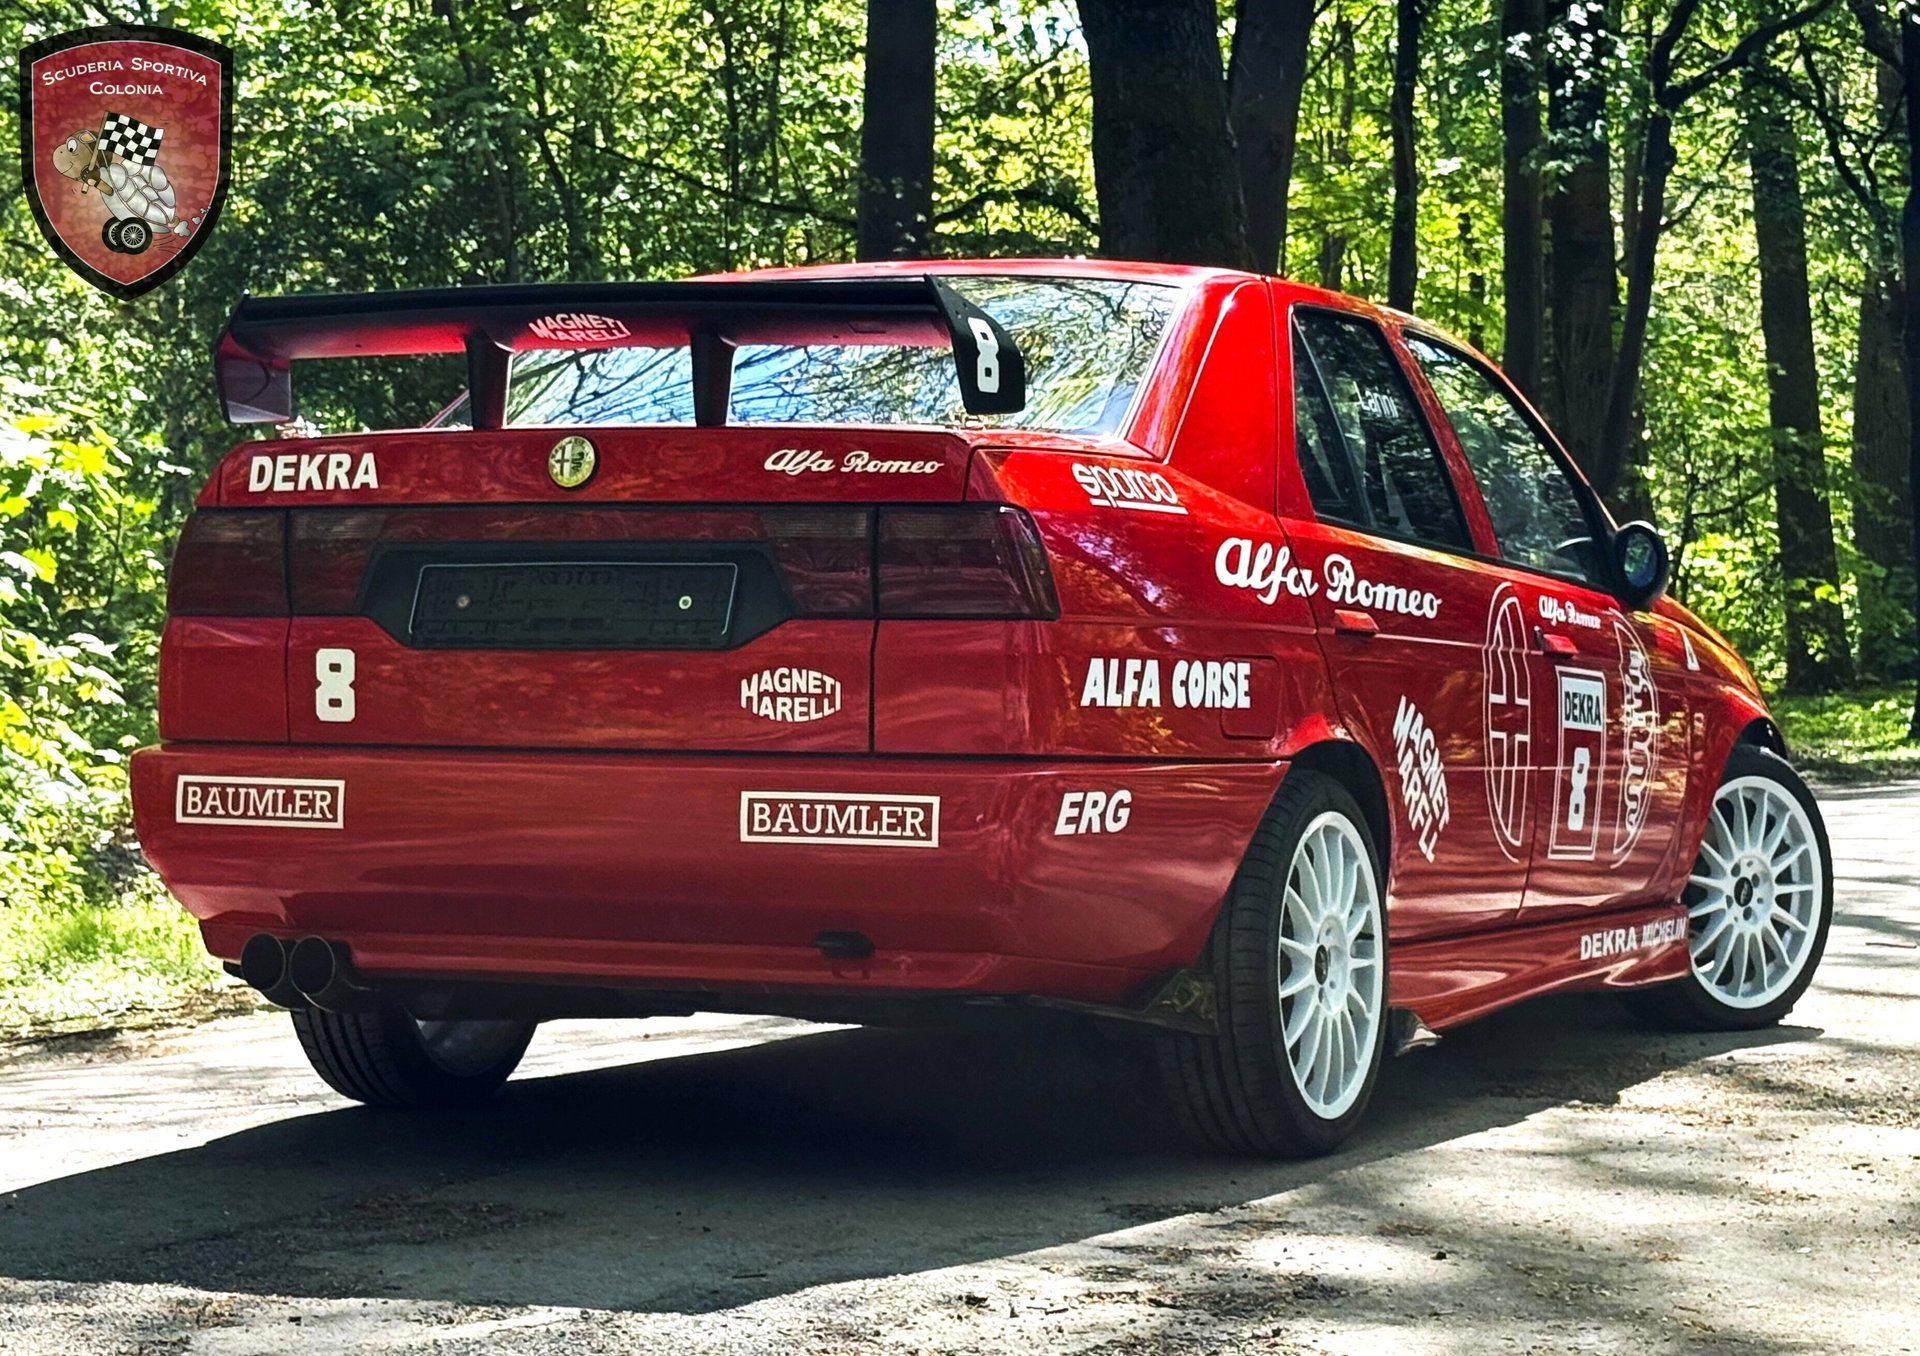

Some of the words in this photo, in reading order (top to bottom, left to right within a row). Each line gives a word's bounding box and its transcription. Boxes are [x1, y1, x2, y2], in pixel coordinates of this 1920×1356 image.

[968, 316, 1000, 394] 8
[248, 452, 379, 492] DEKRA
[763, 448, 836, 476] Alfa
[840, 450, 945, 475] Romeo
[1071, 462, 1179, 508] sparco
[1214, 536, 1320, 606] Alfa
[1323, 553, 1443, 620] Romeo
[1538, 594, 1566, 627] Alfa
[315, 647, 356, 723] 8
[1080, 657, 1161, 708] ALFA
[1172, 659, 1251, 709] CORSE
[1564, 690, 1602, 726] DEKRA
[185, 785, 334, 820] BÄUMLER
[1567, 747, 1591, 832] 8
[752, 801, 928, 838] BÄUMLER
[1054, 789, 1133, 836] ERG
[1580, 926, 1638, 961] DEKRA
[1640, 916, 1689, 948] MICHELIN
